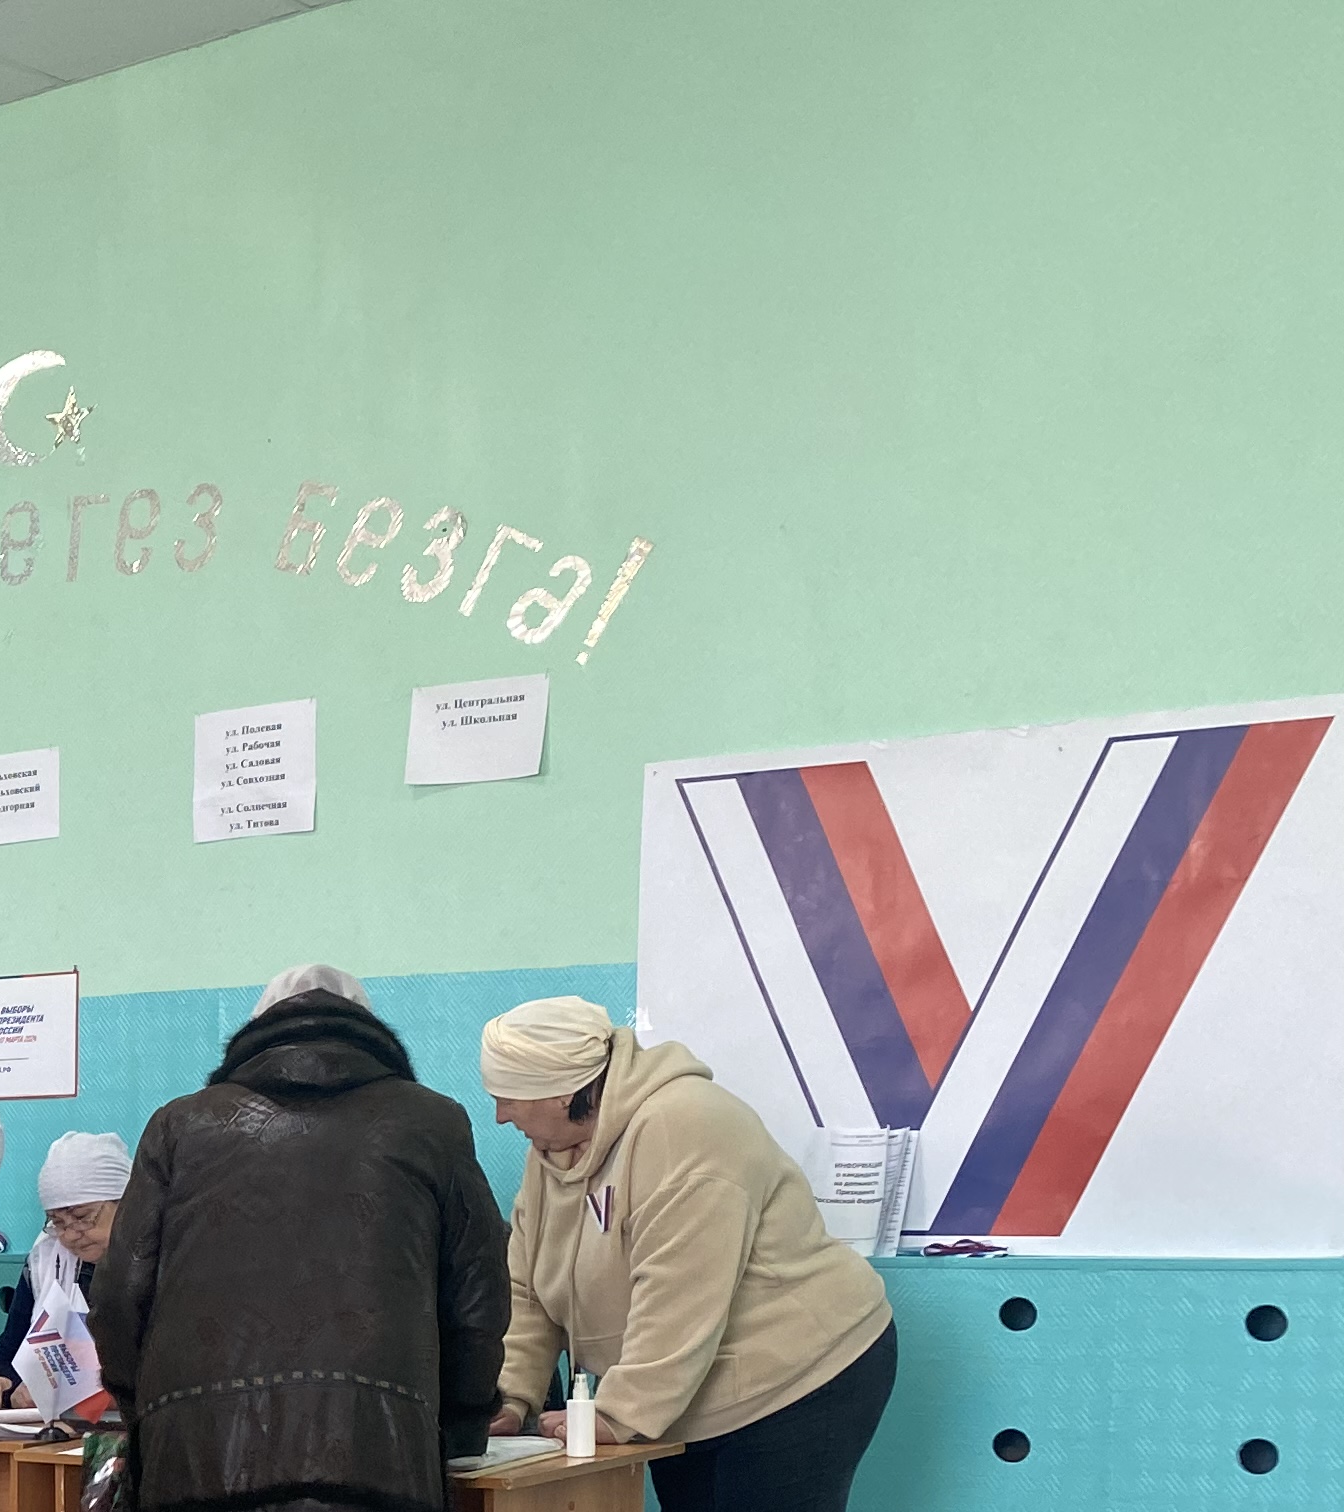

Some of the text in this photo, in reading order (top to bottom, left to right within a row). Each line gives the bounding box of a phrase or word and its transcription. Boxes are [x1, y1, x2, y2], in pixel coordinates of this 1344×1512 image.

[435, 694, 526, 713] ул. Центральная
[441, 713, 518, 730] ул. Школьная
[225, 722, 283, 740] ул. Полевая
[225, 740, 281, 756] ул. Рабочая
[225, 756, 281, 773] ул. Садовая
[220, 773, 286, 790] ул. Совхозная
[220, 801, 288, 817] ул. Солнечная
[229, 819, 280, 833] ул. Титова
[0, 1004, 34, 1015] ВЫБОРЫ
